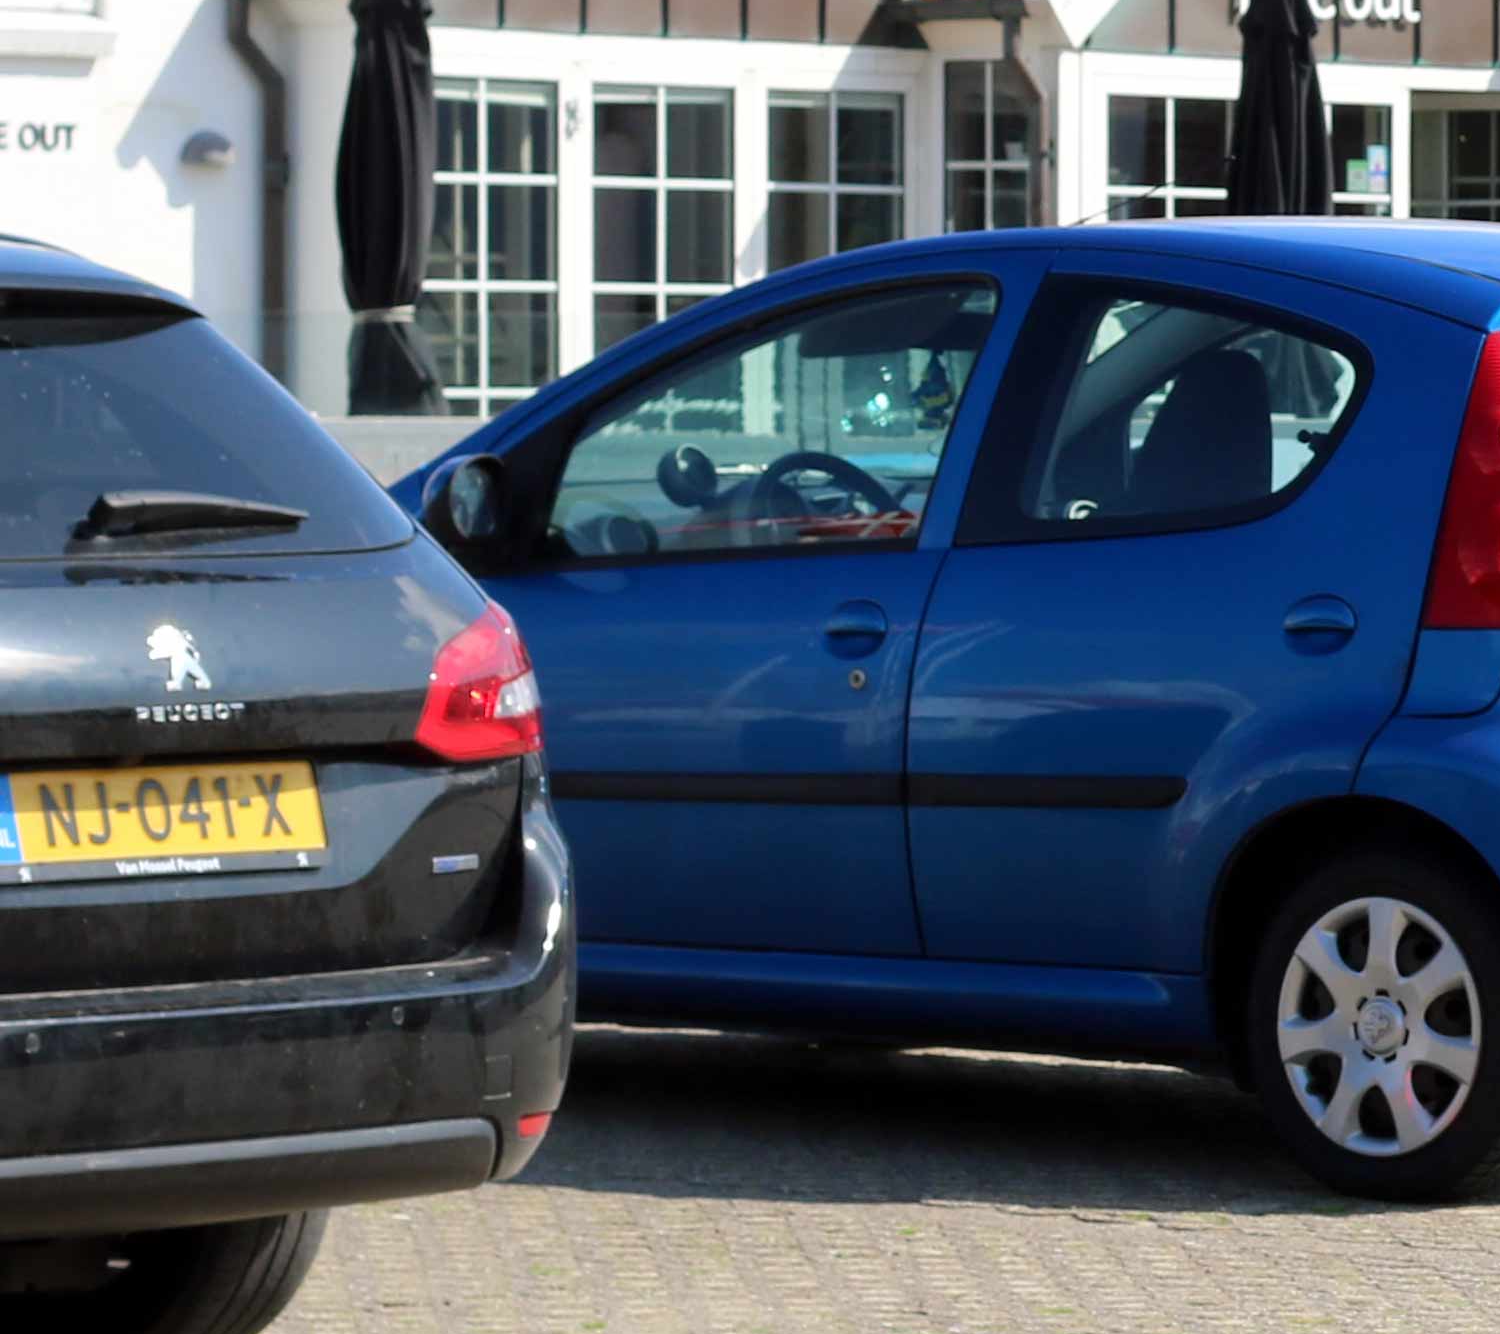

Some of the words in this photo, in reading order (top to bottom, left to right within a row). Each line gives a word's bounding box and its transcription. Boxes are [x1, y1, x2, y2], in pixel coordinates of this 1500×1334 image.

[18, 121, 77, 152] OUT
[135, 702, 245, 723] PEUGEOT
[38, 773, 292, 849] NJ-041-X
